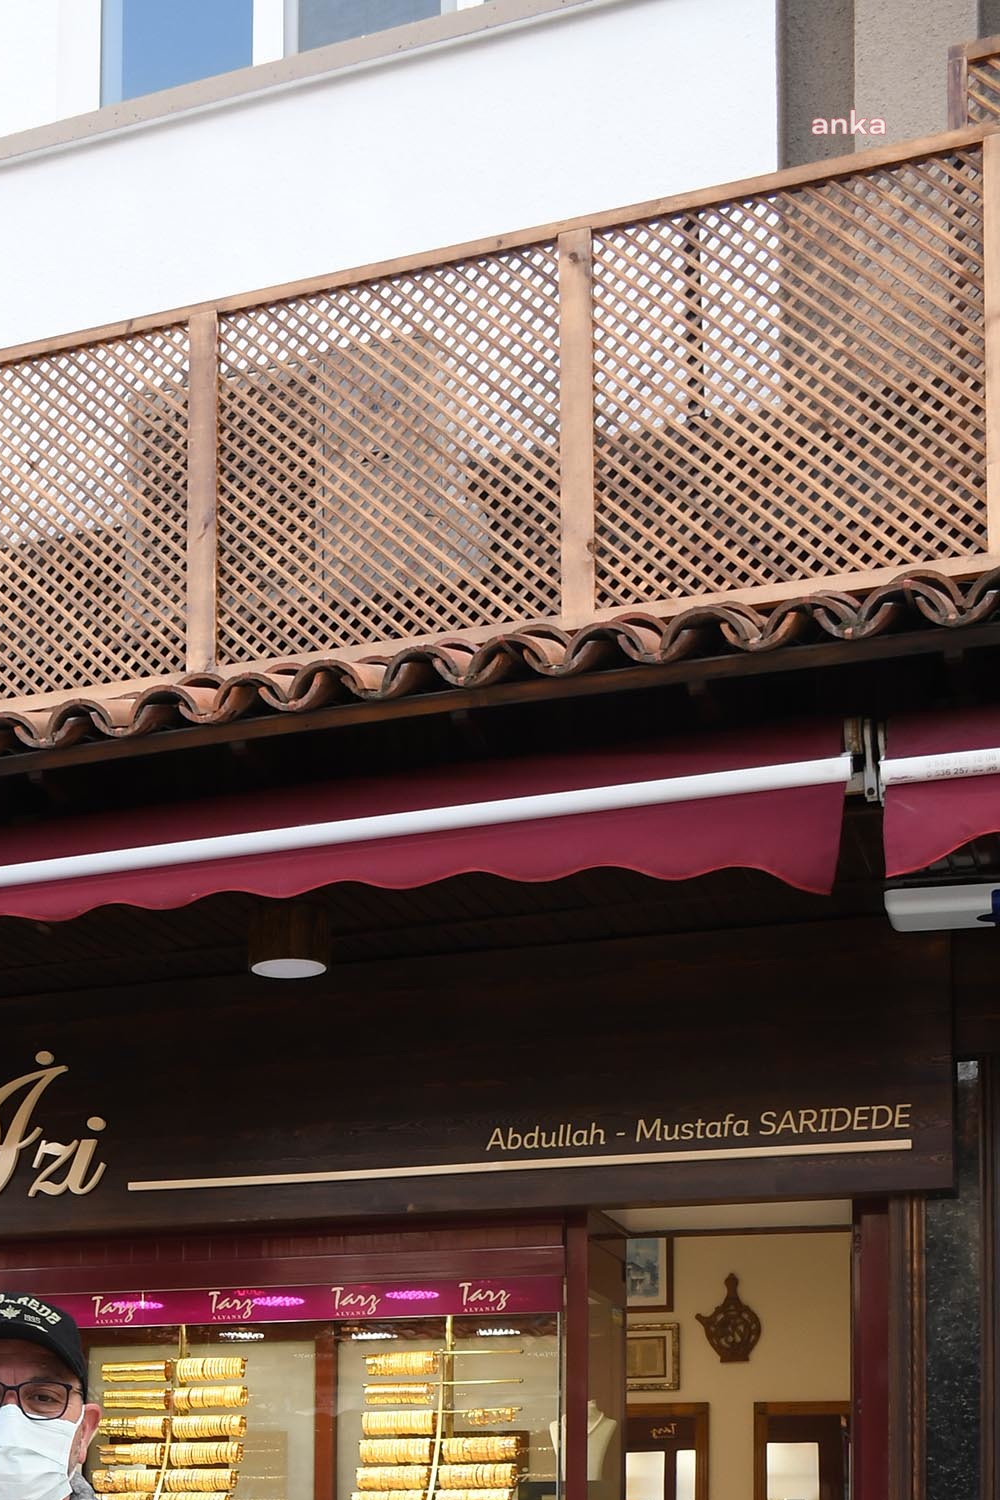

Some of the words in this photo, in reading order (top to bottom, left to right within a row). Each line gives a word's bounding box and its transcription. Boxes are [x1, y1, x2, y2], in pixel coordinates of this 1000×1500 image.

[486, 1122, 606, 1151] Abdullah
[635, 1113, 749, 1143] Mustafa
[759, 1103, 912, 1136] SARIDEDE
[208, 1291, 257, 1319] Tarz
[331, 1286, 382, 1316] Tarz
[459, 1281, 512, 1312] Tarz
